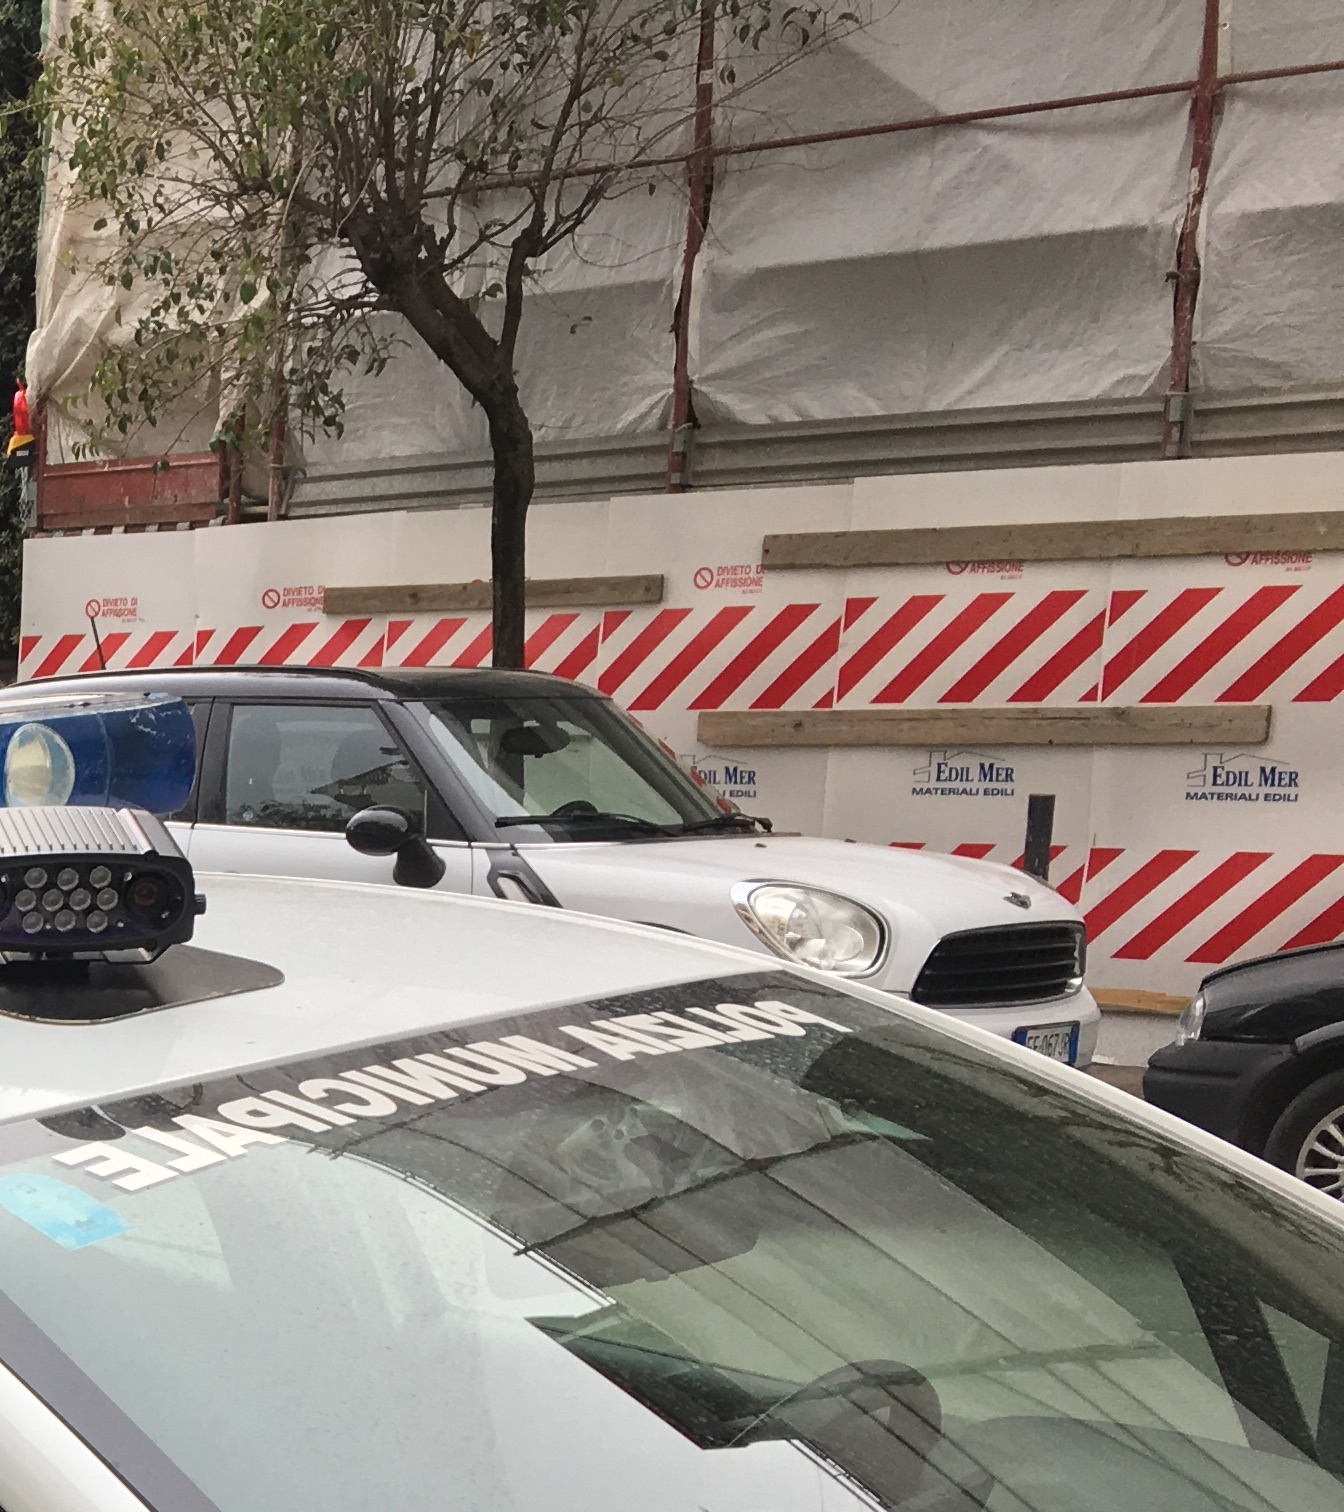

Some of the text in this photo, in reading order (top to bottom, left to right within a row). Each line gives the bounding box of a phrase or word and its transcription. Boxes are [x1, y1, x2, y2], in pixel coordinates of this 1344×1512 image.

[716, 564, 752, 576] DIVIETO
[714, 576, 763, 588] AFFISSIONE
[282, 585, 314, 597] DIVIETO
[281, 597, 324, 608] AFFISSIONE
[723, 765, 757, 785] MER
[935, 762, 1015, 783] EDIL MER
[1211, 765, 1299, 788] EDIL MER
[729, 789, 757, 798] EDILI
[911, 787, 1015, 797] MATERIALI EDILI
[1185, 791, 1299, 802] MATERIALI EDILI
